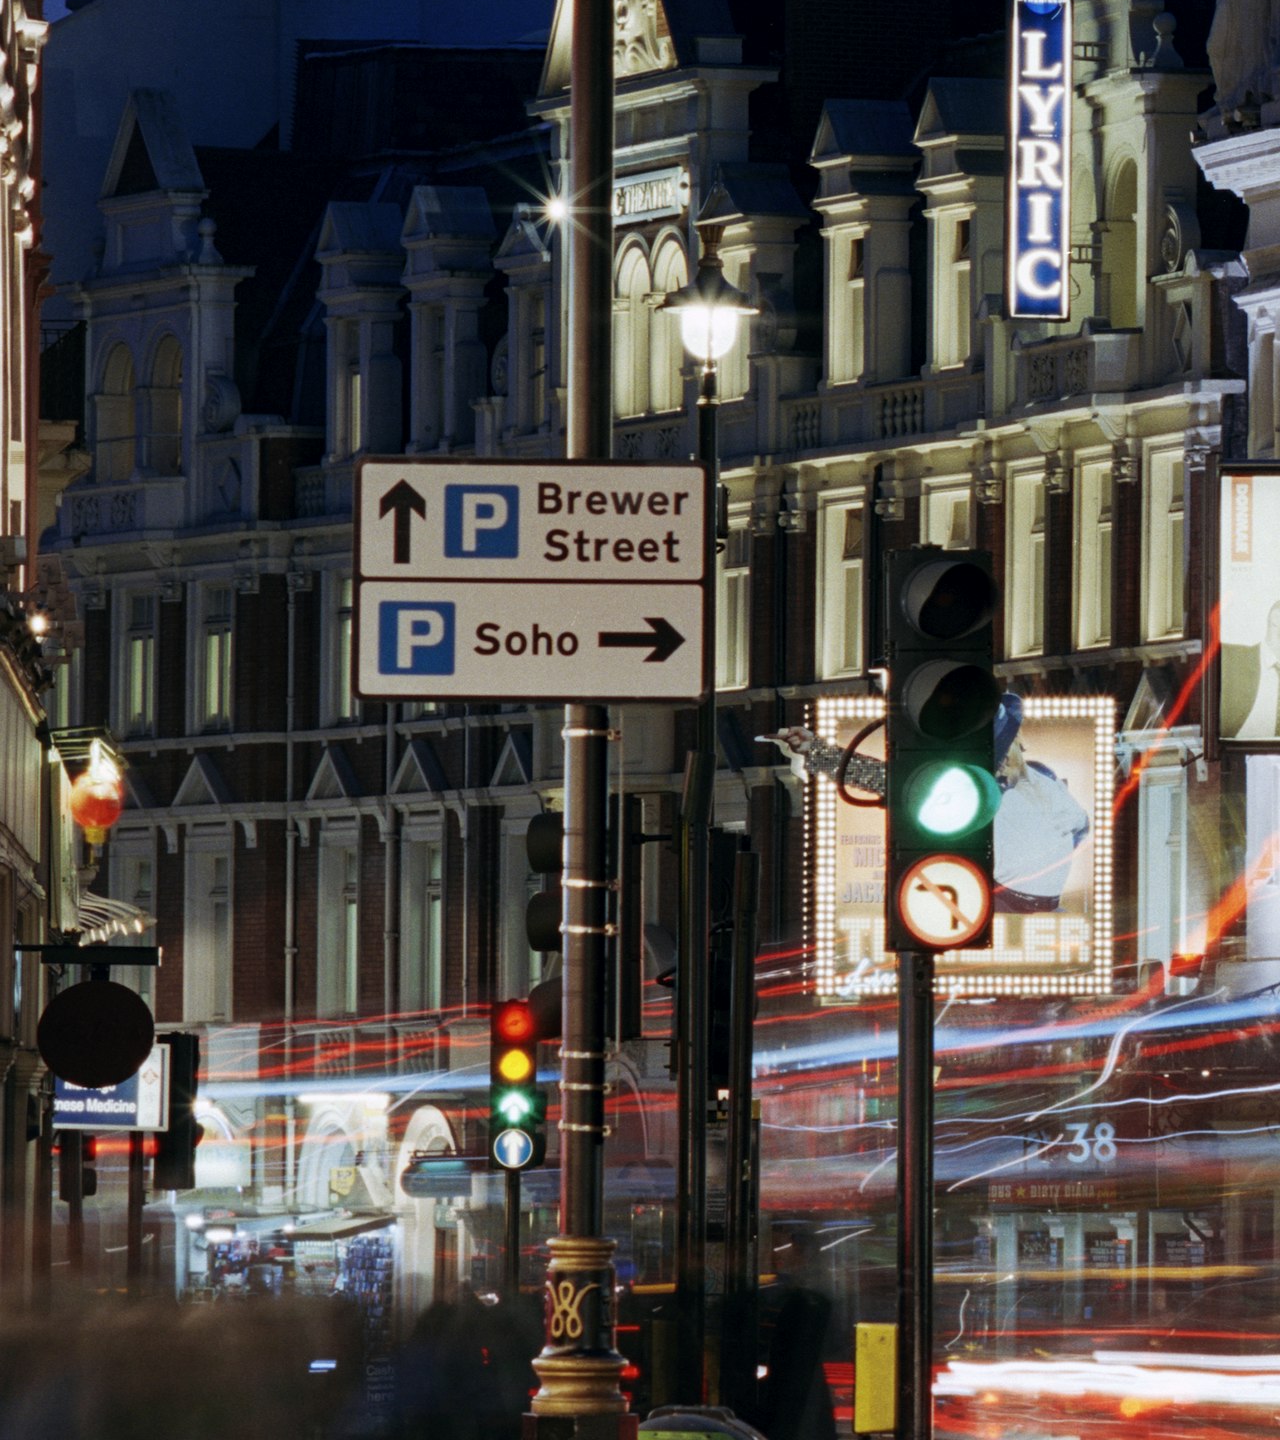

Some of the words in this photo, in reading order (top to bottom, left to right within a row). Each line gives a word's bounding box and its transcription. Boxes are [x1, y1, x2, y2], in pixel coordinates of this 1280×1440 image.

[1017, 31, 1065, 299] LYRIC
[537, 482, 689, 515] Brewer
[543, 529, 680, 562] Street
[473, 622, 579, 656] Soho
[86, 1098, 137, 1114] Medicine
[1064, 1122, 1118, 1164] 38
